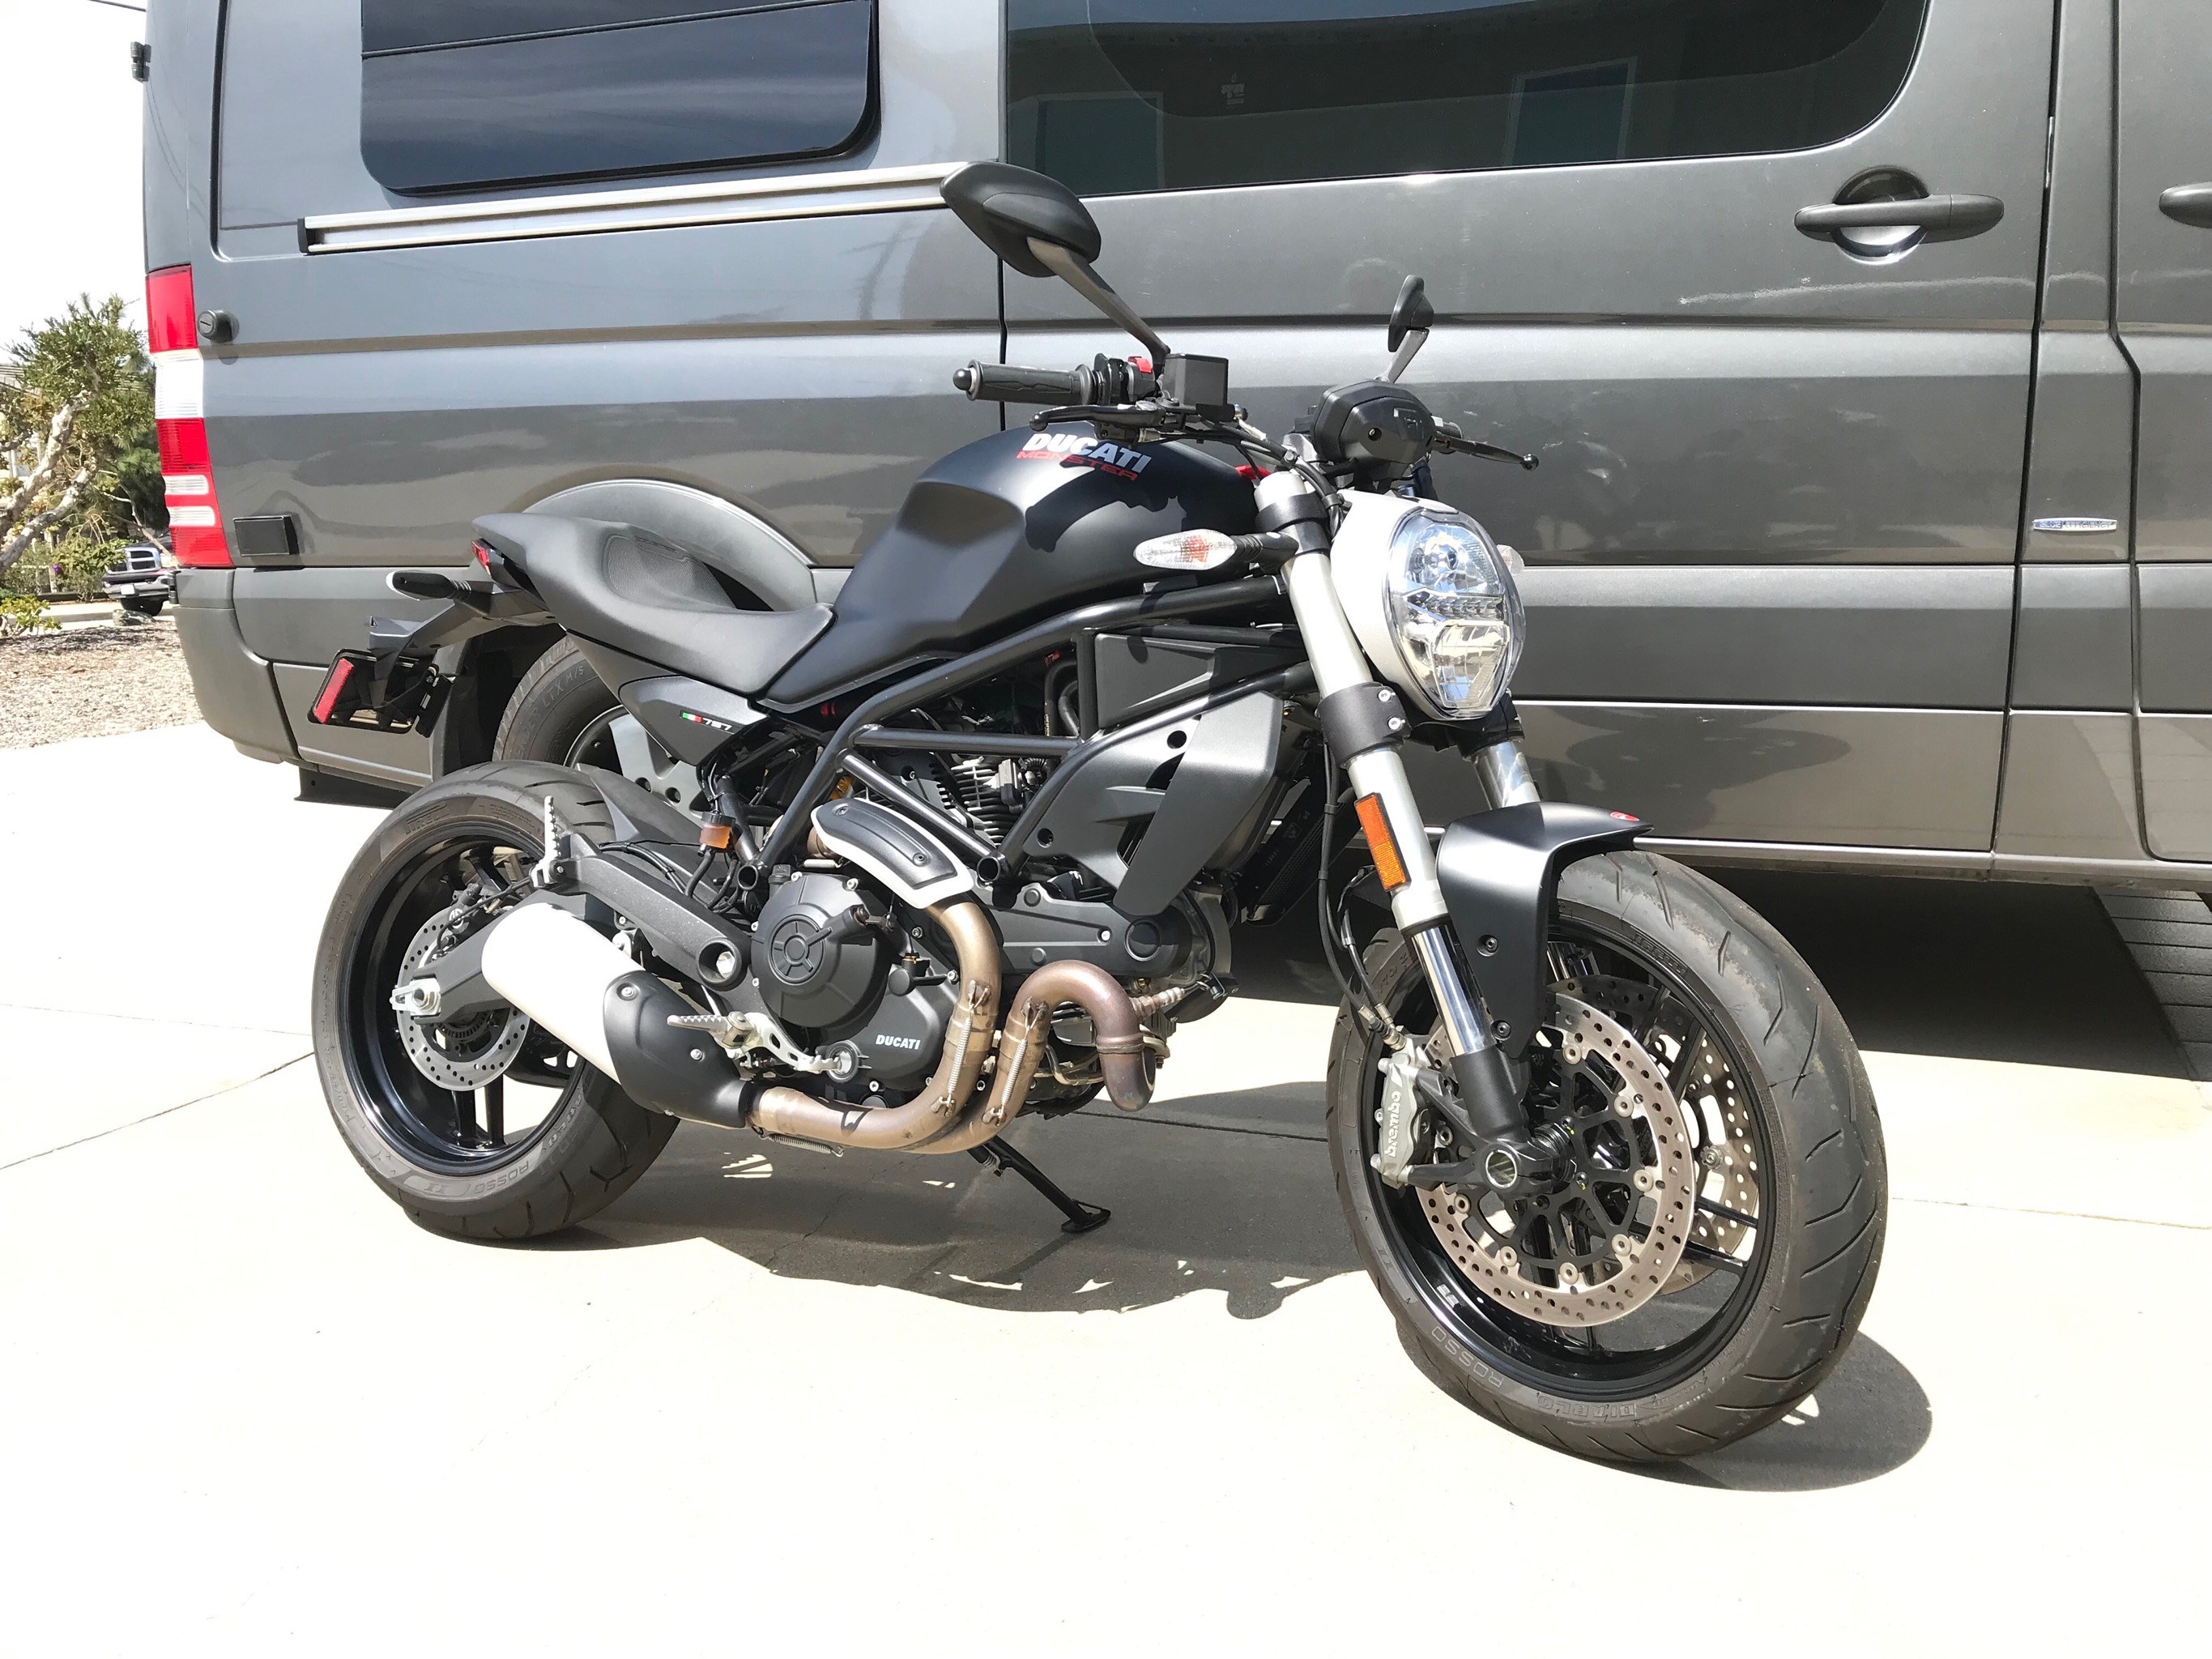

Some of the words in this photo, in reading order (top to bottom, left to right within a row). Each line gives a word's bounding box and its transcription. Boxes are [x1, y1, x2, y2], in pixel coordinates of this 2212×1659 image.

[1016, 450, 1138, 481] MONSTER
[1021, 433, 1152, 473] DUCATI
[702, 717, 732, 731] 797
[876, 1034, 921, 1050] DUCATI
[1383, 1090, 1402, 1158] brembo
[1430, 1325, 1504, 1388] ROSSO
